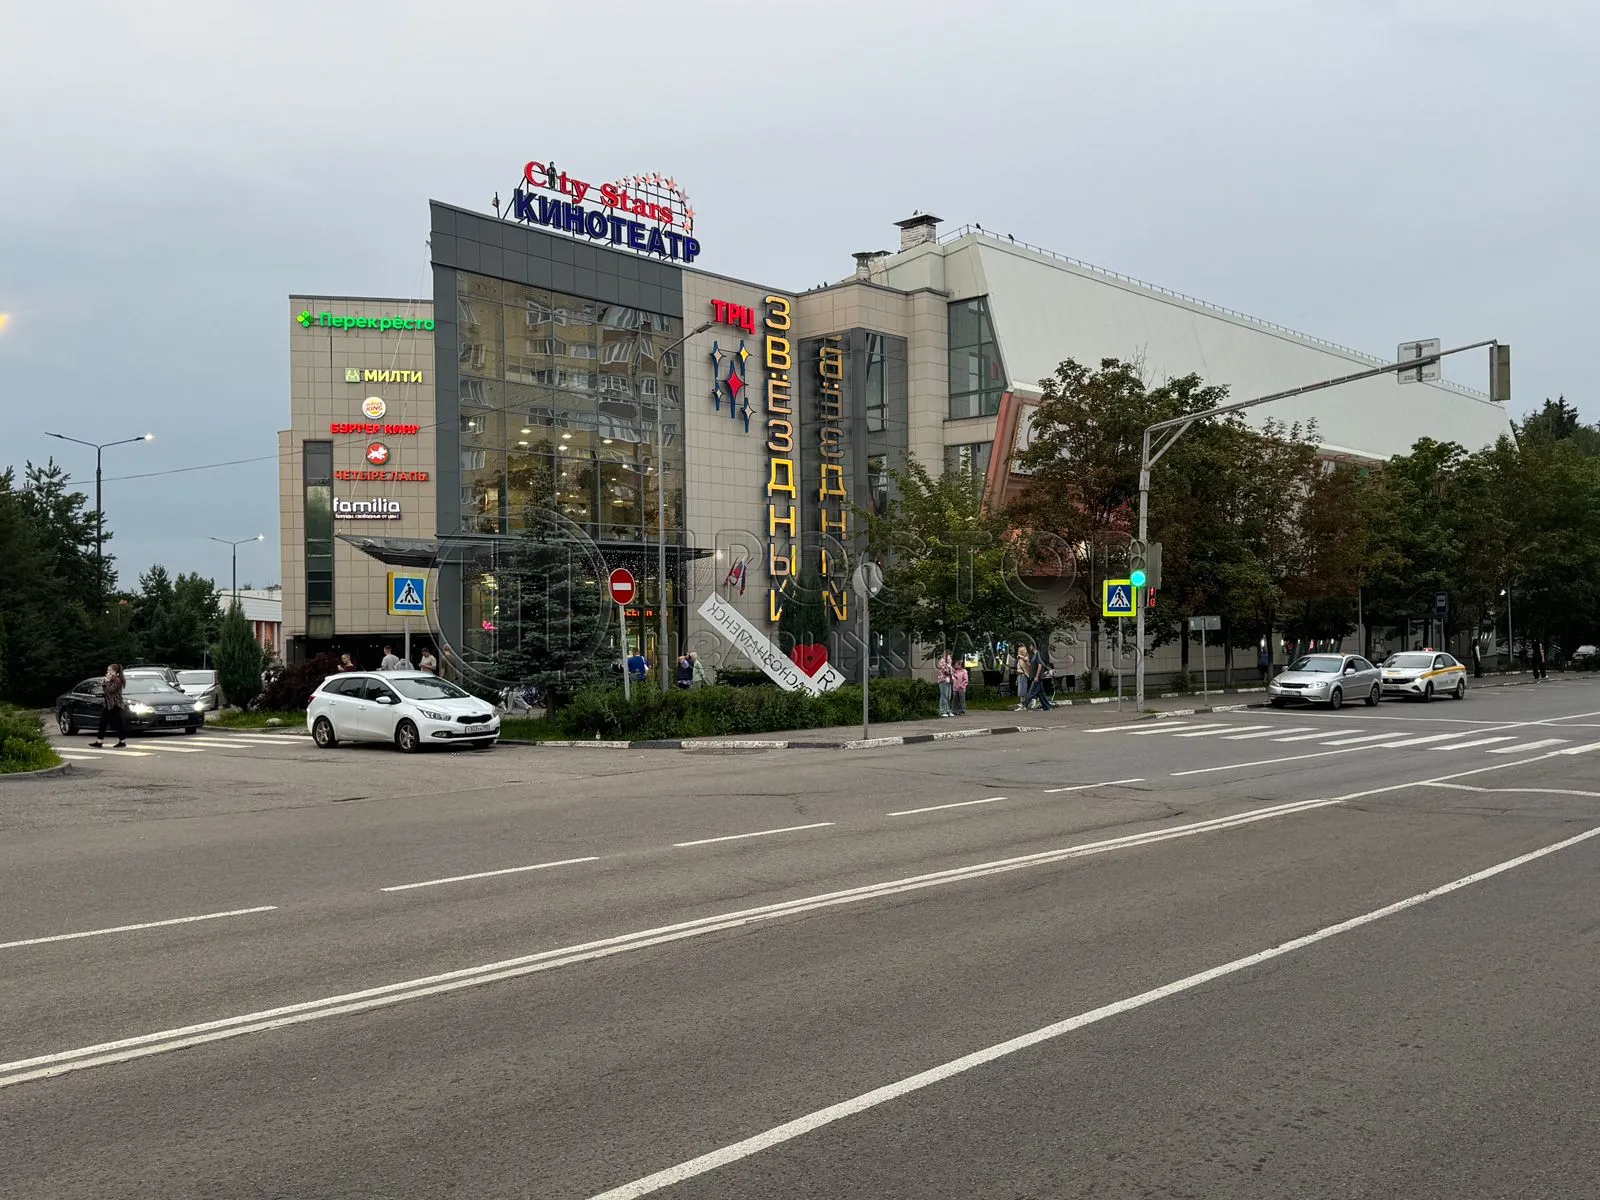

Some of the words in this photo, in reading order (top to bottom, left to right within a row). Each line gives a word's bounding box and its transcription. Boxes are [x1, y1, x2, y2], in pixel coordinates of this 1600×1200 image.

[600, 183, 673, 224] Stars
[514, 188, 700, 263] КИНОТЕАТР
[711, 299, 756, 335] ТРЦ
[364, 369, 423, 383] МИЛТИ
[331, 424, 382, 434] БУРГЕР
[335, 470, 387, 481] ЧЕТЫРЕ
[390, 471, 429, 481] ЛАПЫ
[333, 497, 400, 512] familia
